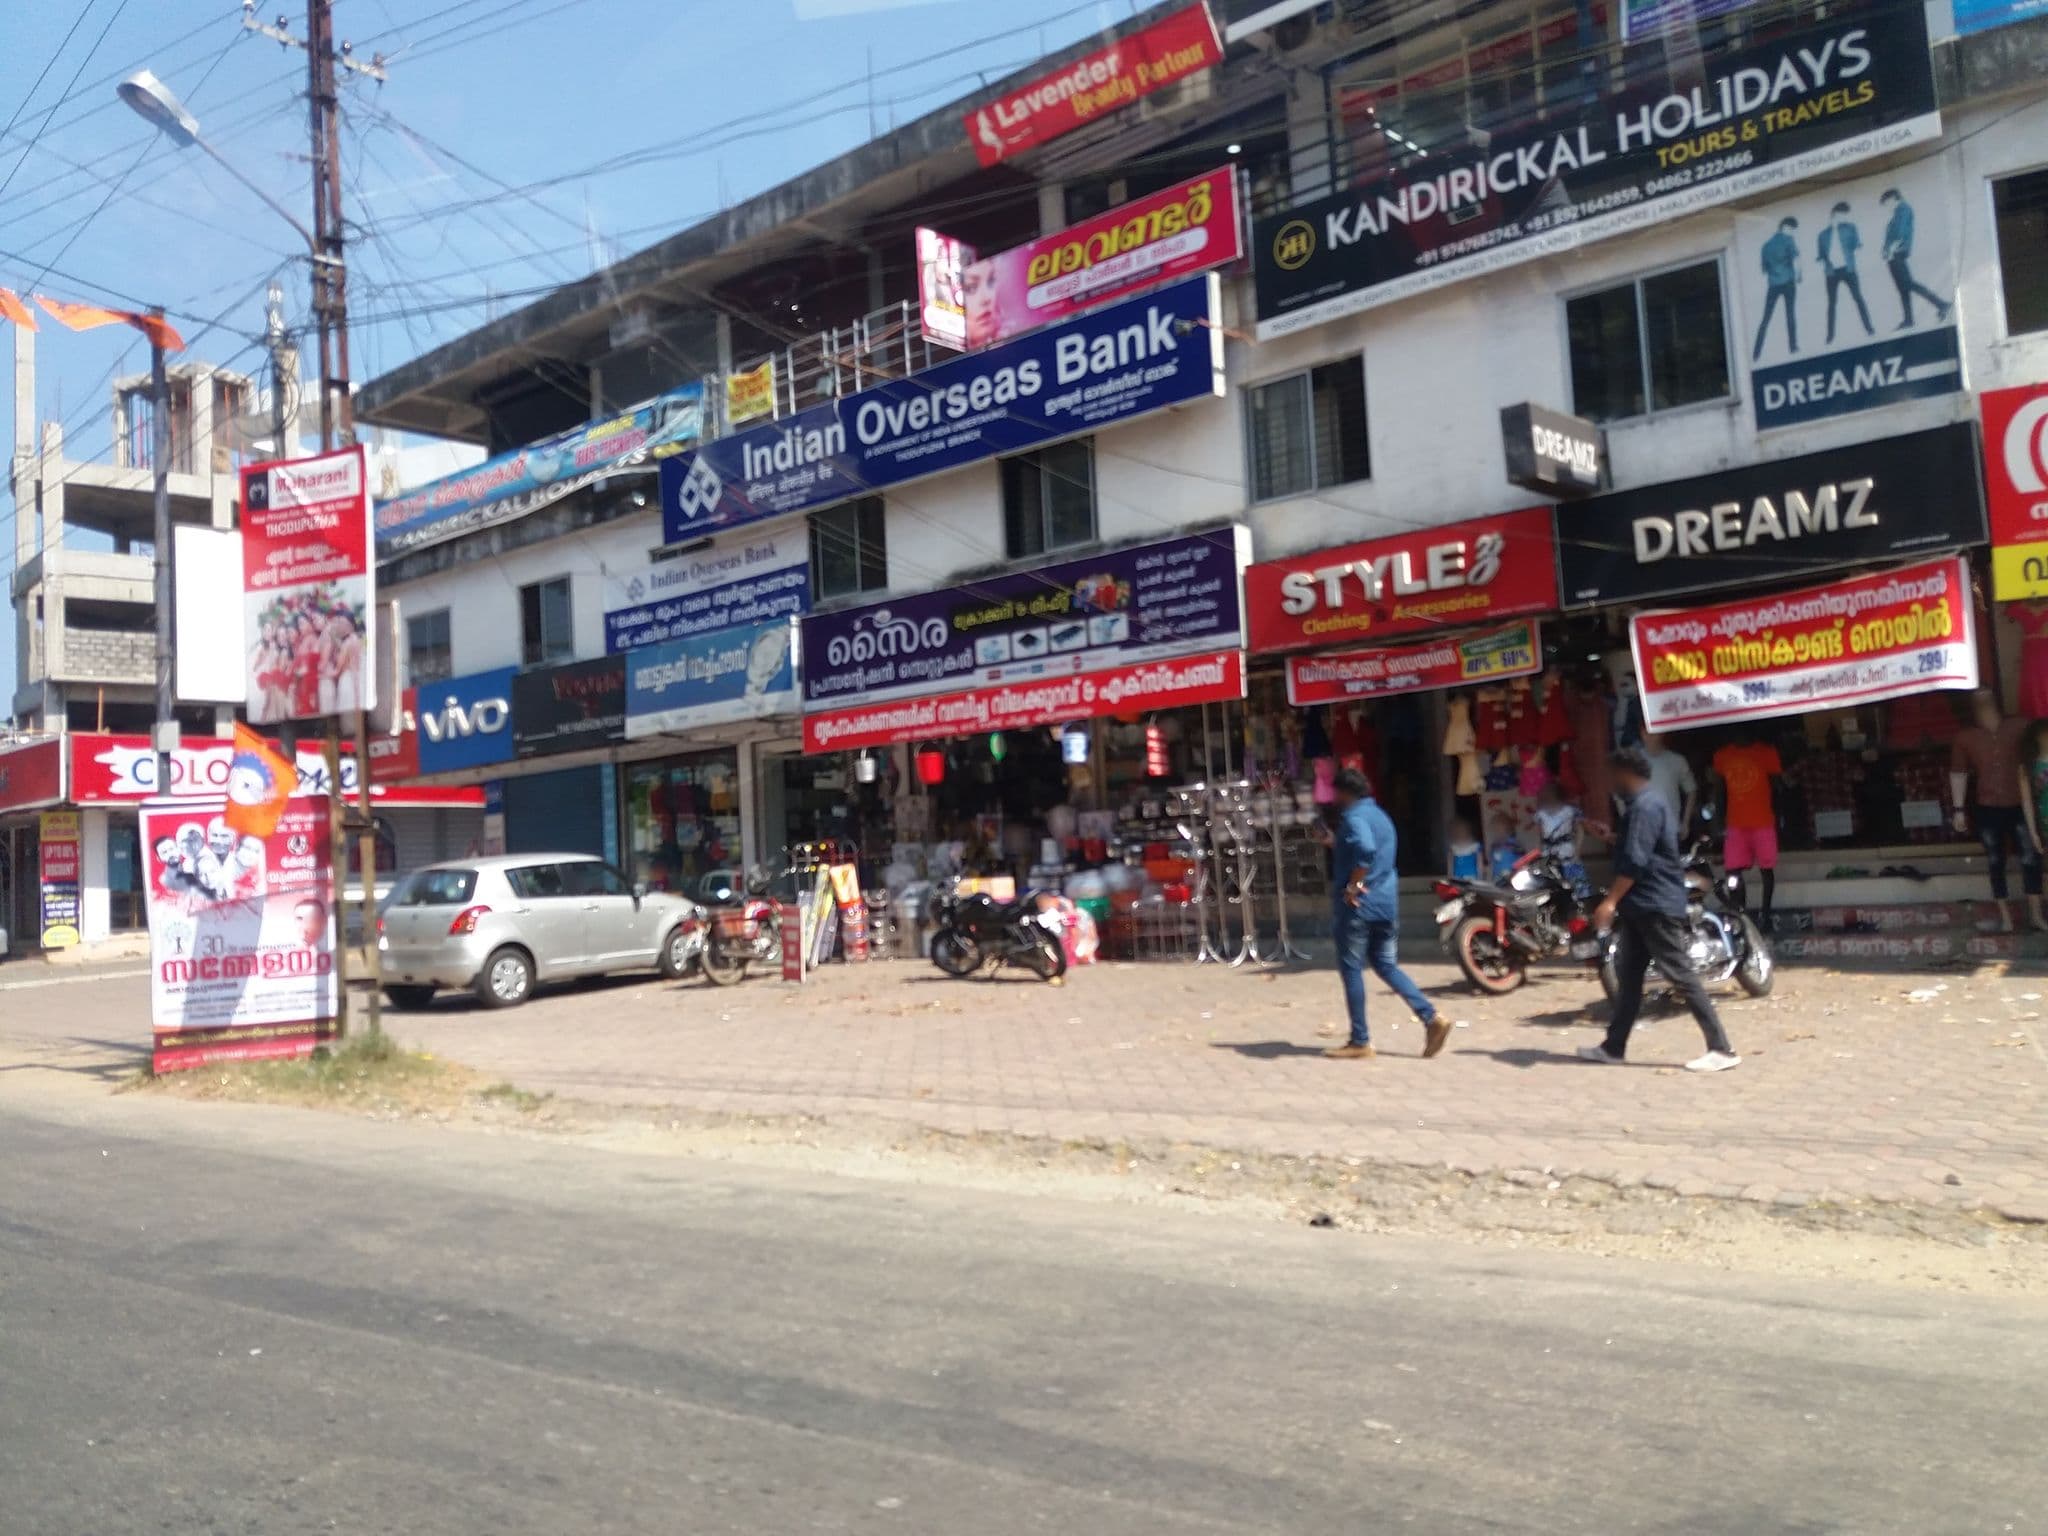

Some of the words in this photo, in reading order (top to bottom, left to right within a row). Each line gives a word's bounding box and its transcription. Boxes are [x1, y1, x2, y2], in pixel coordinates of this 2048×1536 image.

[994, 53, 1120, 128] Lavender
[1071, 77, 1136, 118] Beauty
[1326, 126, 1606, 252] KANDIRICKAL
[1617, 30, 1872, 154] HOLIDAYS
[1657, 126, 1737, 169] TOURS
[1740, 119, 1759, 142] &
[1762, 81, 1875, 133] TRAVELS
[1881, 127, 1912, 146] USA
[1694, 151, 1754, 181] 222466
[742, 421, 846, 482] Indian
[856, 357, 1044, 445] Overseas
[1056, 306, 1178, 386] Bank
[1763, 356, 1906, 411] DREAMZ
[1531, 424, 1598, 472] DREAMZ
[265, 513, 340, 538] THODUPUZHA
[1632, 477, 1879, 565] DREAMZ
[650, 569, 688, 591] Indian
[690, 556, 741, 579] Overseas
[744, 543, 777, 560] Bank
[1302, 611, 1371, 636] Clothing
[1392, 593, 1491, 621] Accessories
[1851, 598, 1952, 651] സെയിൽ
[422, 696, 509, 742] vivo
